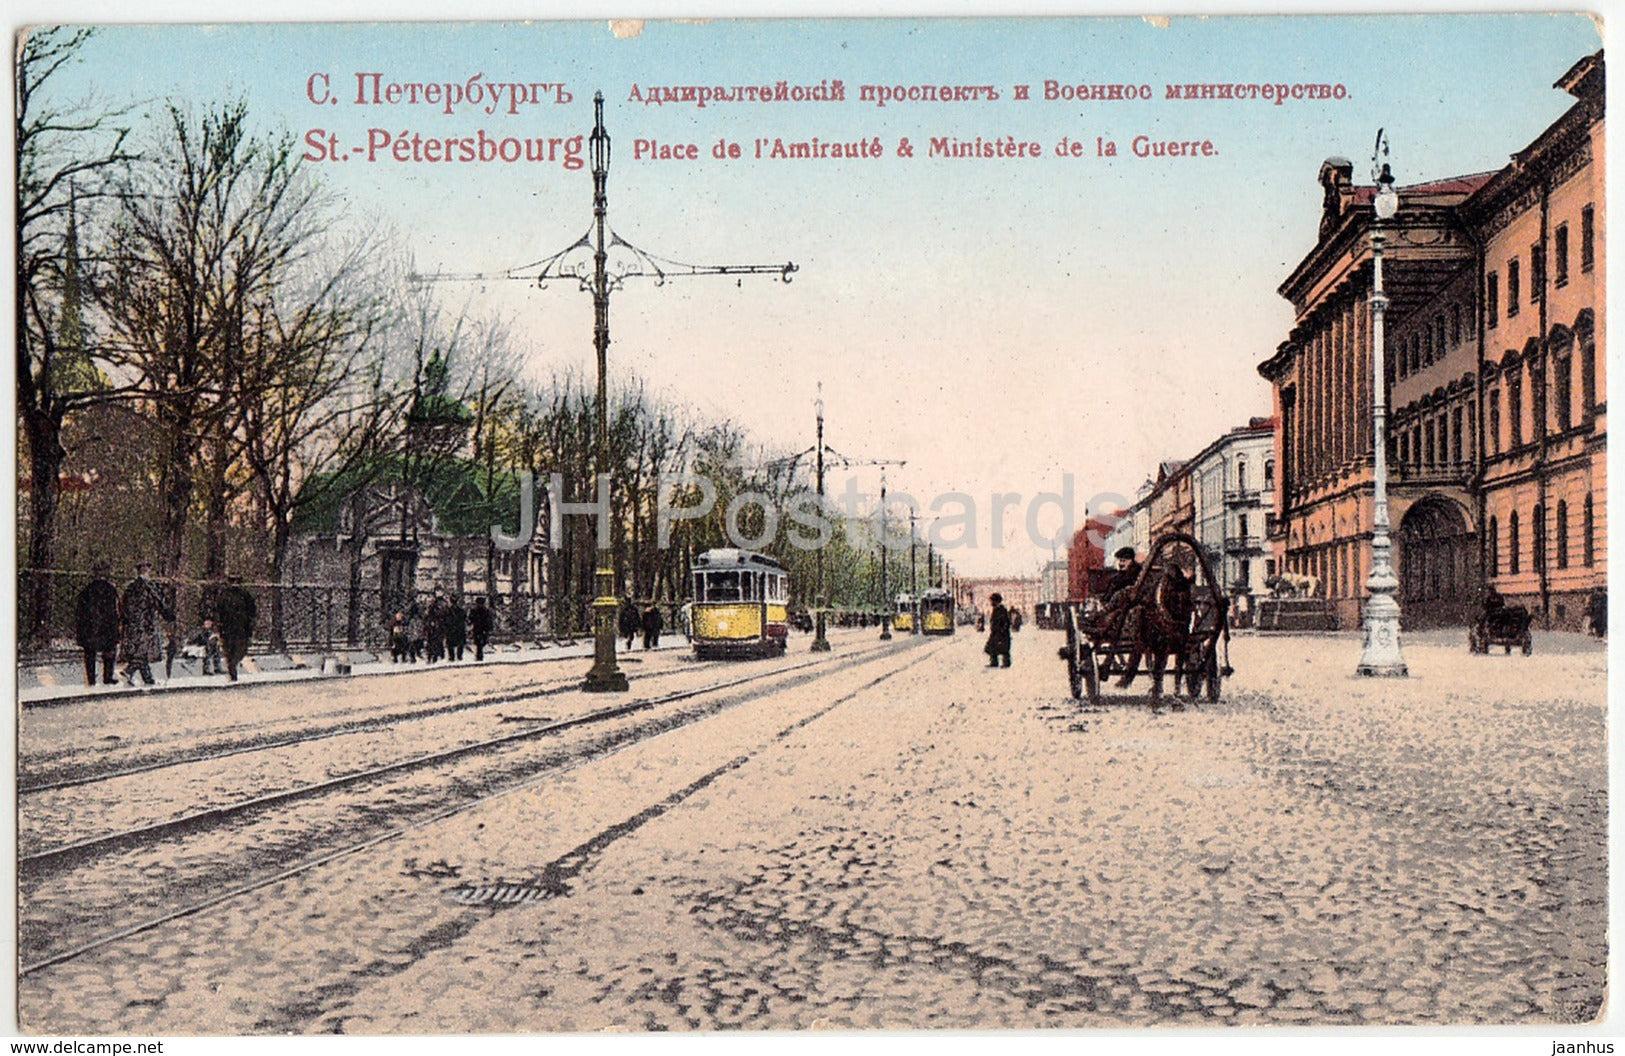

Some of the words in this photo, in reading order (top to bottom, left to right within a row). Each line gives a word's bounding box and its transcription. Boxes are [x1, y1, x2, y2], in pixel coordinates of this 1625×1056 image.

[306, 74, 338, 105] С.
[355, 72, 573, 115] Петербургъ
[859, 84, 1000, 108] проспектъ
[1013, 84, 1030, 102] и
[1165, 83, 1353, 106] министерство.
[304, 128, 585, 171] St.-Pétersbourg
[633, 138, 700, 161] Place
[711, 138, 742, 160] de
[896, 136, 914, 159] &
[928, 135, 1042, 159] Ministère
[1054, 137, 1084, 158] de
[1096, 137, 1117, 158] la
[1131, 136, 1219, 159] Guerre.
